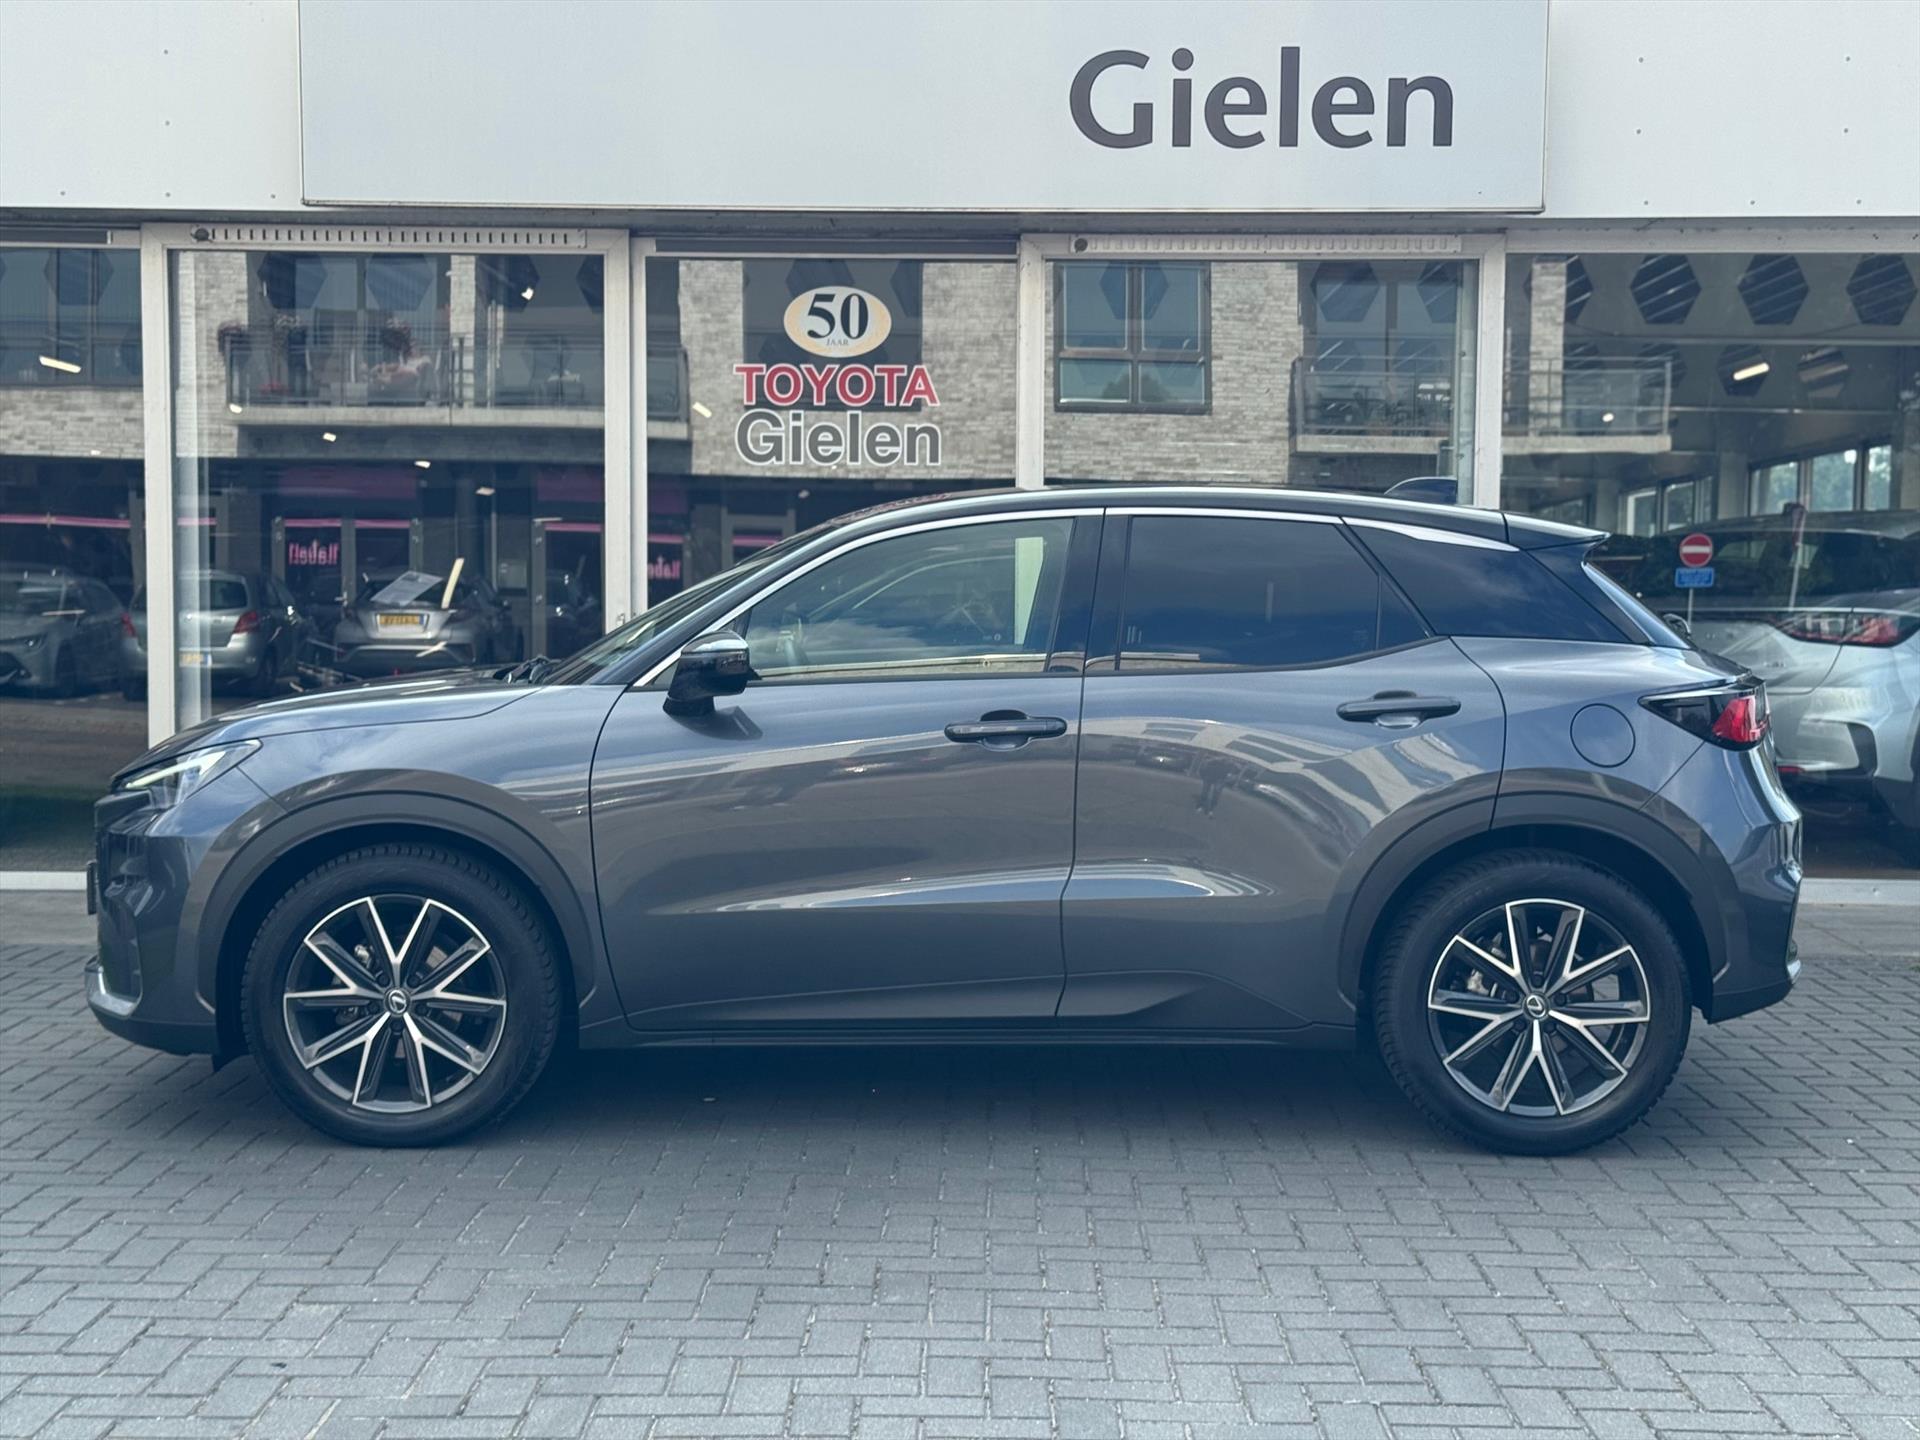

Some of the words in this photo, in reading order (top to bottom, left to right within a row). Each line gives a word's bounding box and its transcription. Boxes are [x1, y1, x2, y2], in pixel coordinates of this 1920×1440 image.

[1069, 46, 1453, 149] Gielen
[807, 293, 869, 340] 50
[825, 338, 850, 347] JAAR
[733, 363, 940, 407] TOYOTA
[735, 408, 942, 466] Gielen
